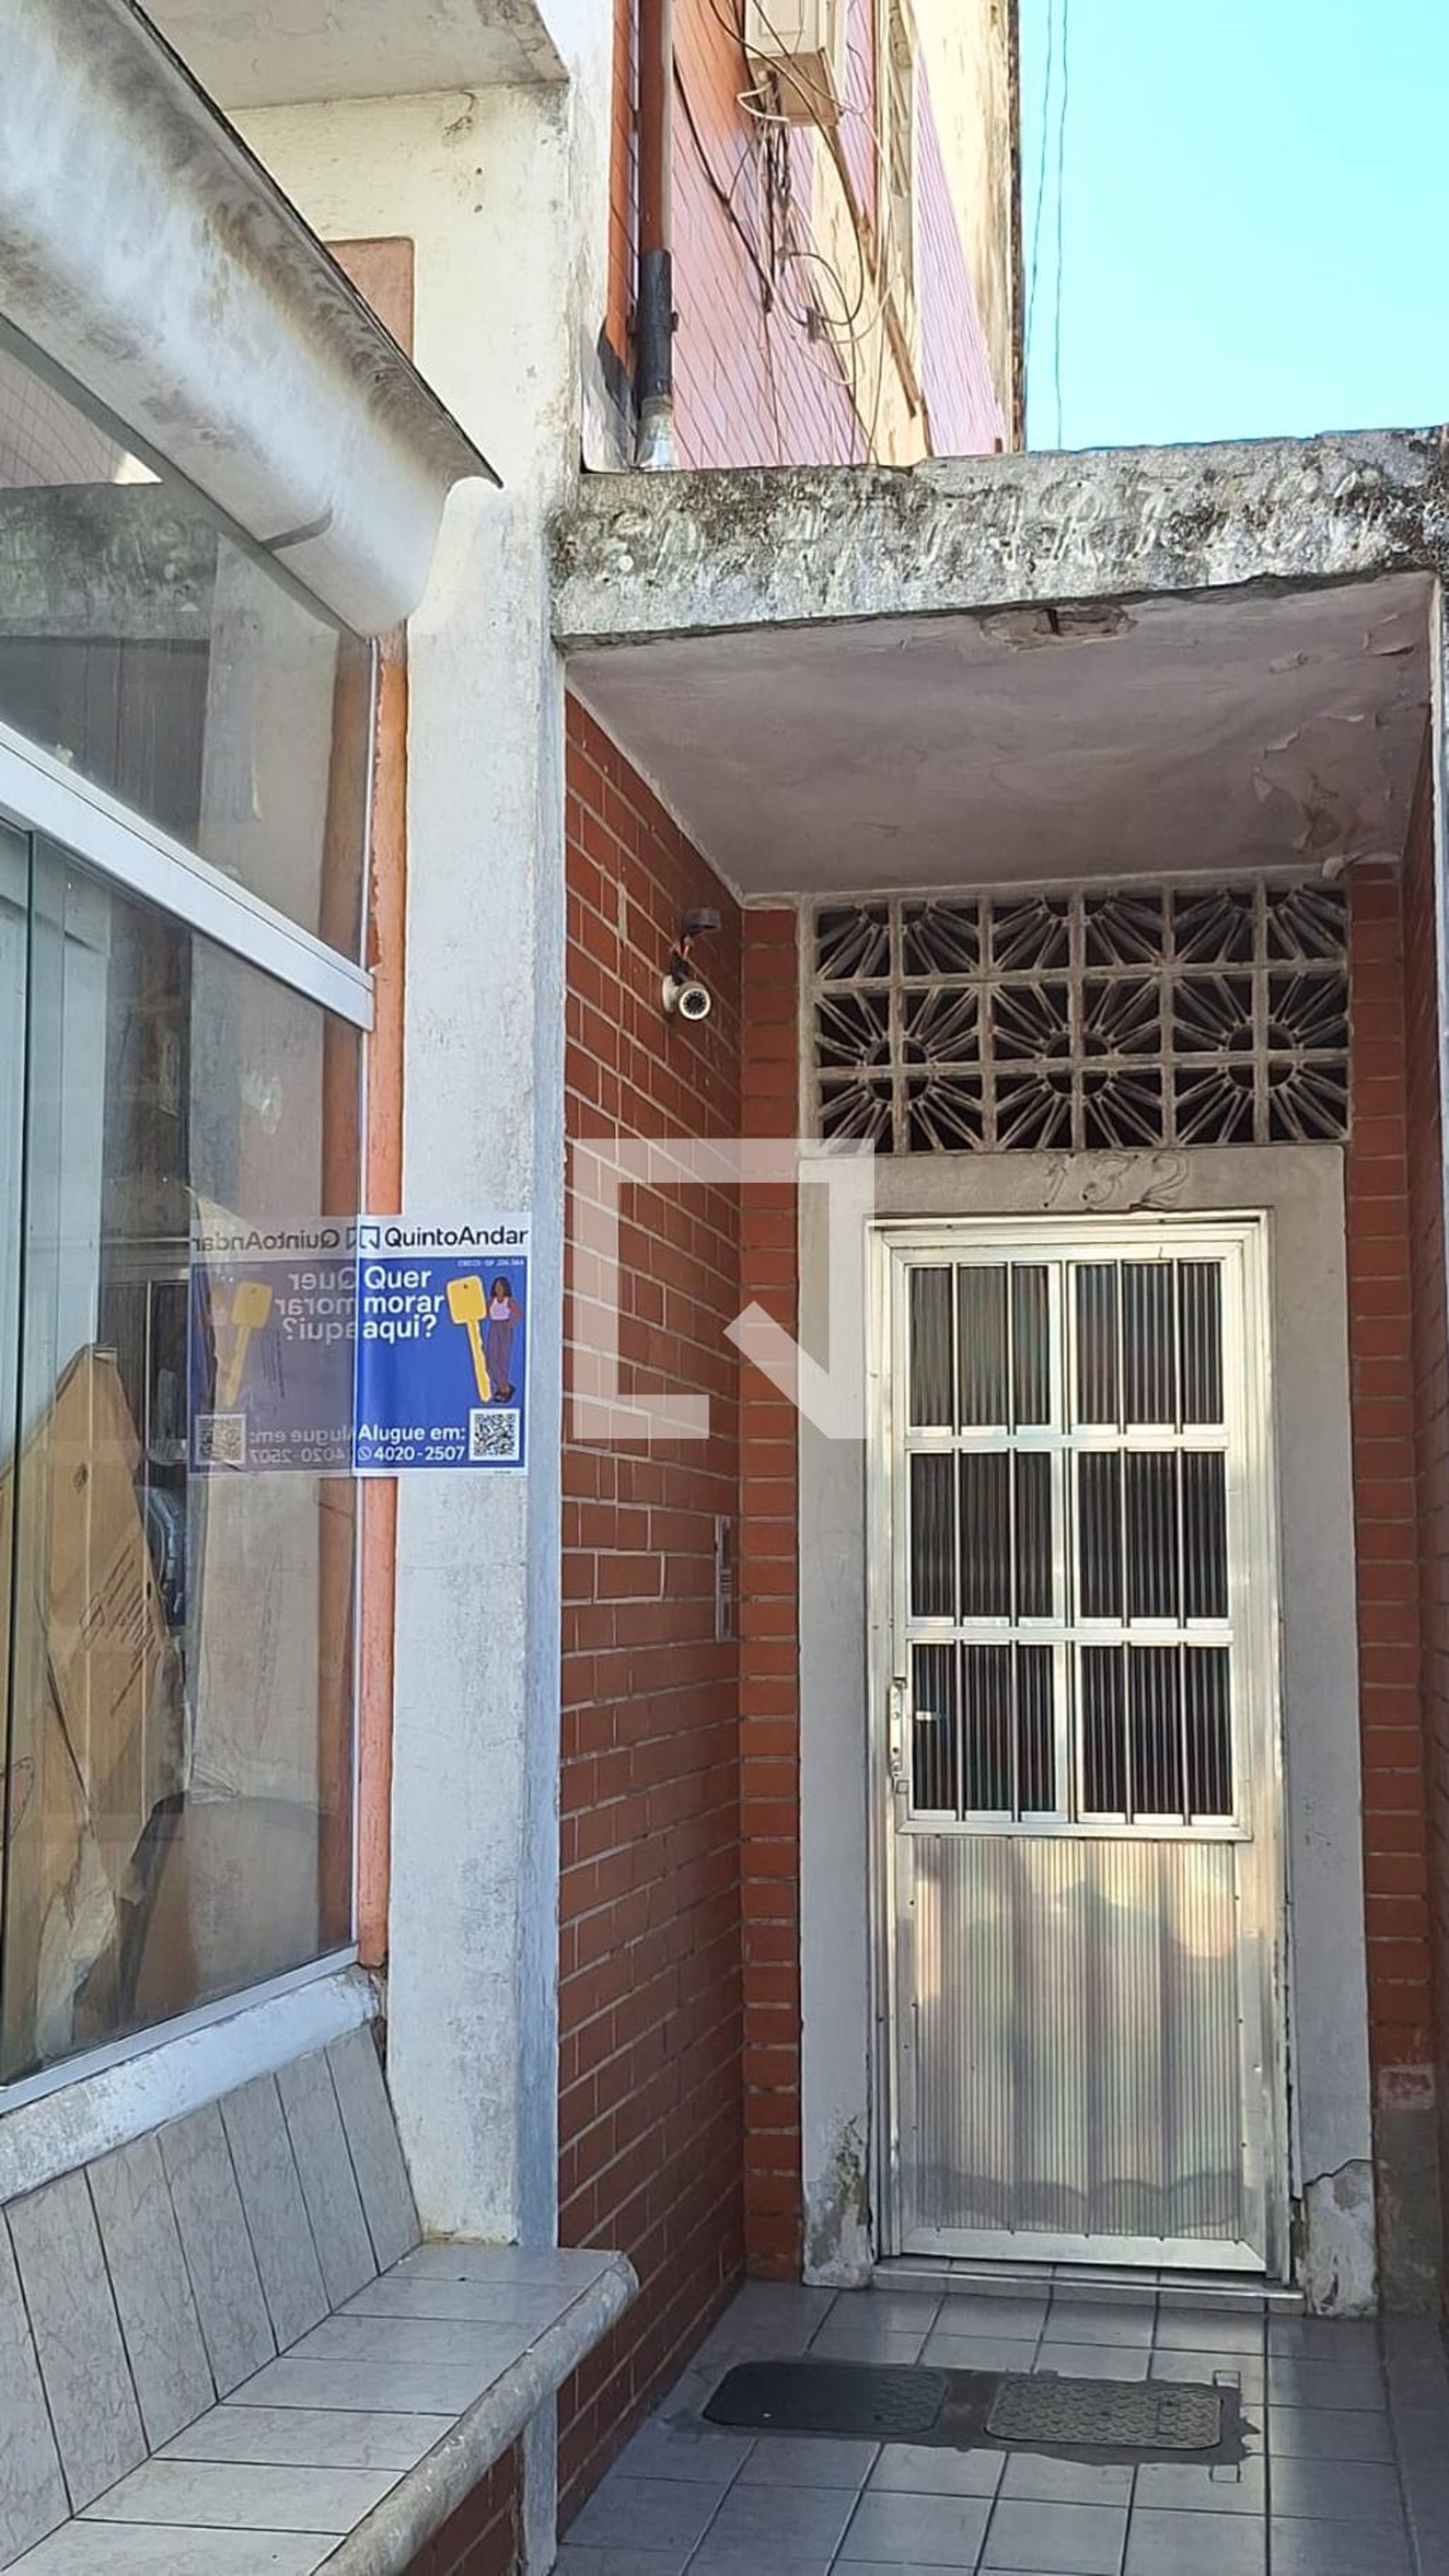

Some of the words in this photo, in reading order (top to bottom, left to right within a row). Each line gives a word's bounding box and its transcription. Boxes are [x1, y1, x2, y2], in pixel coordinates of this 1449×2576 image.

[385, 1225, 529, 1248] QuintoAndar
[364, 1265, 432, 1289] Quer
[364, 1294, 445, 1313] morar
[363, 1313, 437, 1344] aqui?
[358, 1424, 425, 1445] Alugue
[430, 1427, 466, 1441] em:
[373, 1445, 465, 1461] 4020-2507
